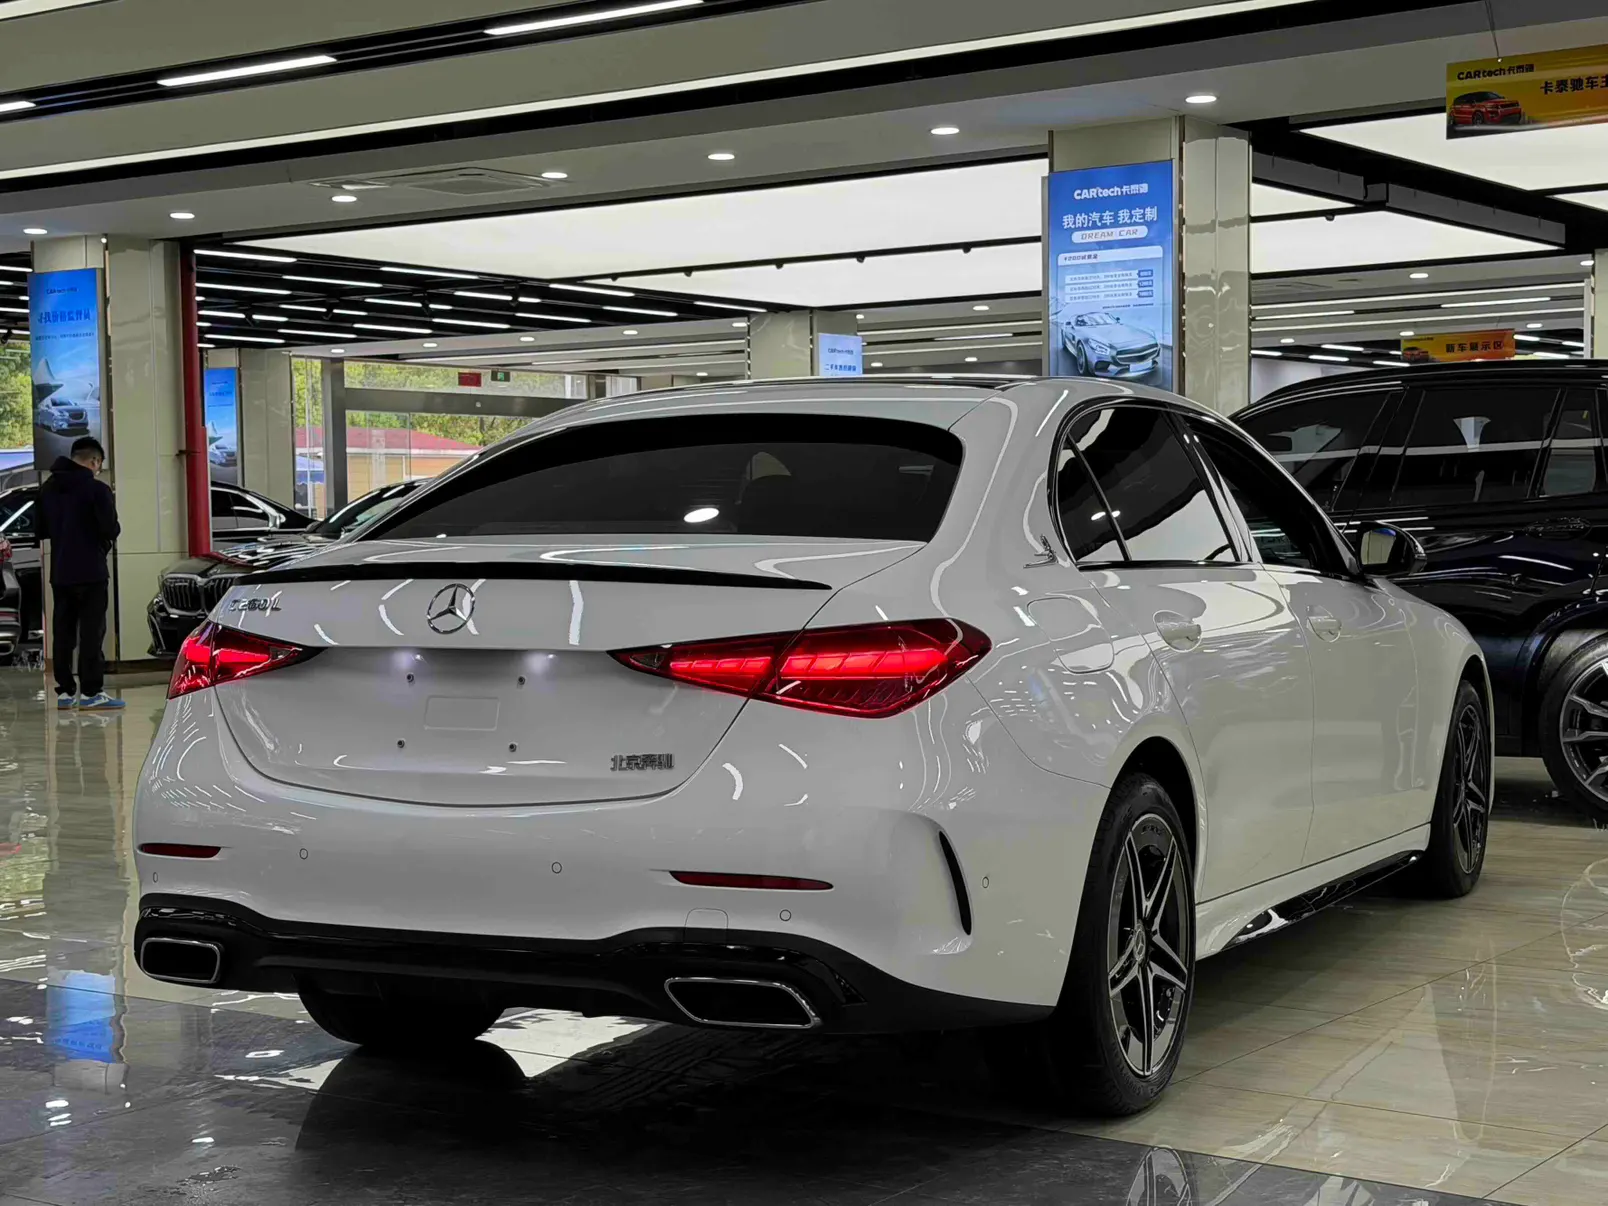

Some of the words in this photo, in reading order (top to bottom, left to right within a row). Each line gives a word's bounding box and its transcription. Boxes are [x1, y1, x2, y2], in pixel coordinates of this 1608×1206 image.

[1062, 210, 1115, 229] 我的汽车
[1117, 205, 1158, 224] 我定制
[1080, 231, 1114, 240] DREAM
[1118, 228, 1139, 237] CAR
[1445, 340, 1504, 353] 新车展示区
[610, 753, 675, 771] 北京奔驰
